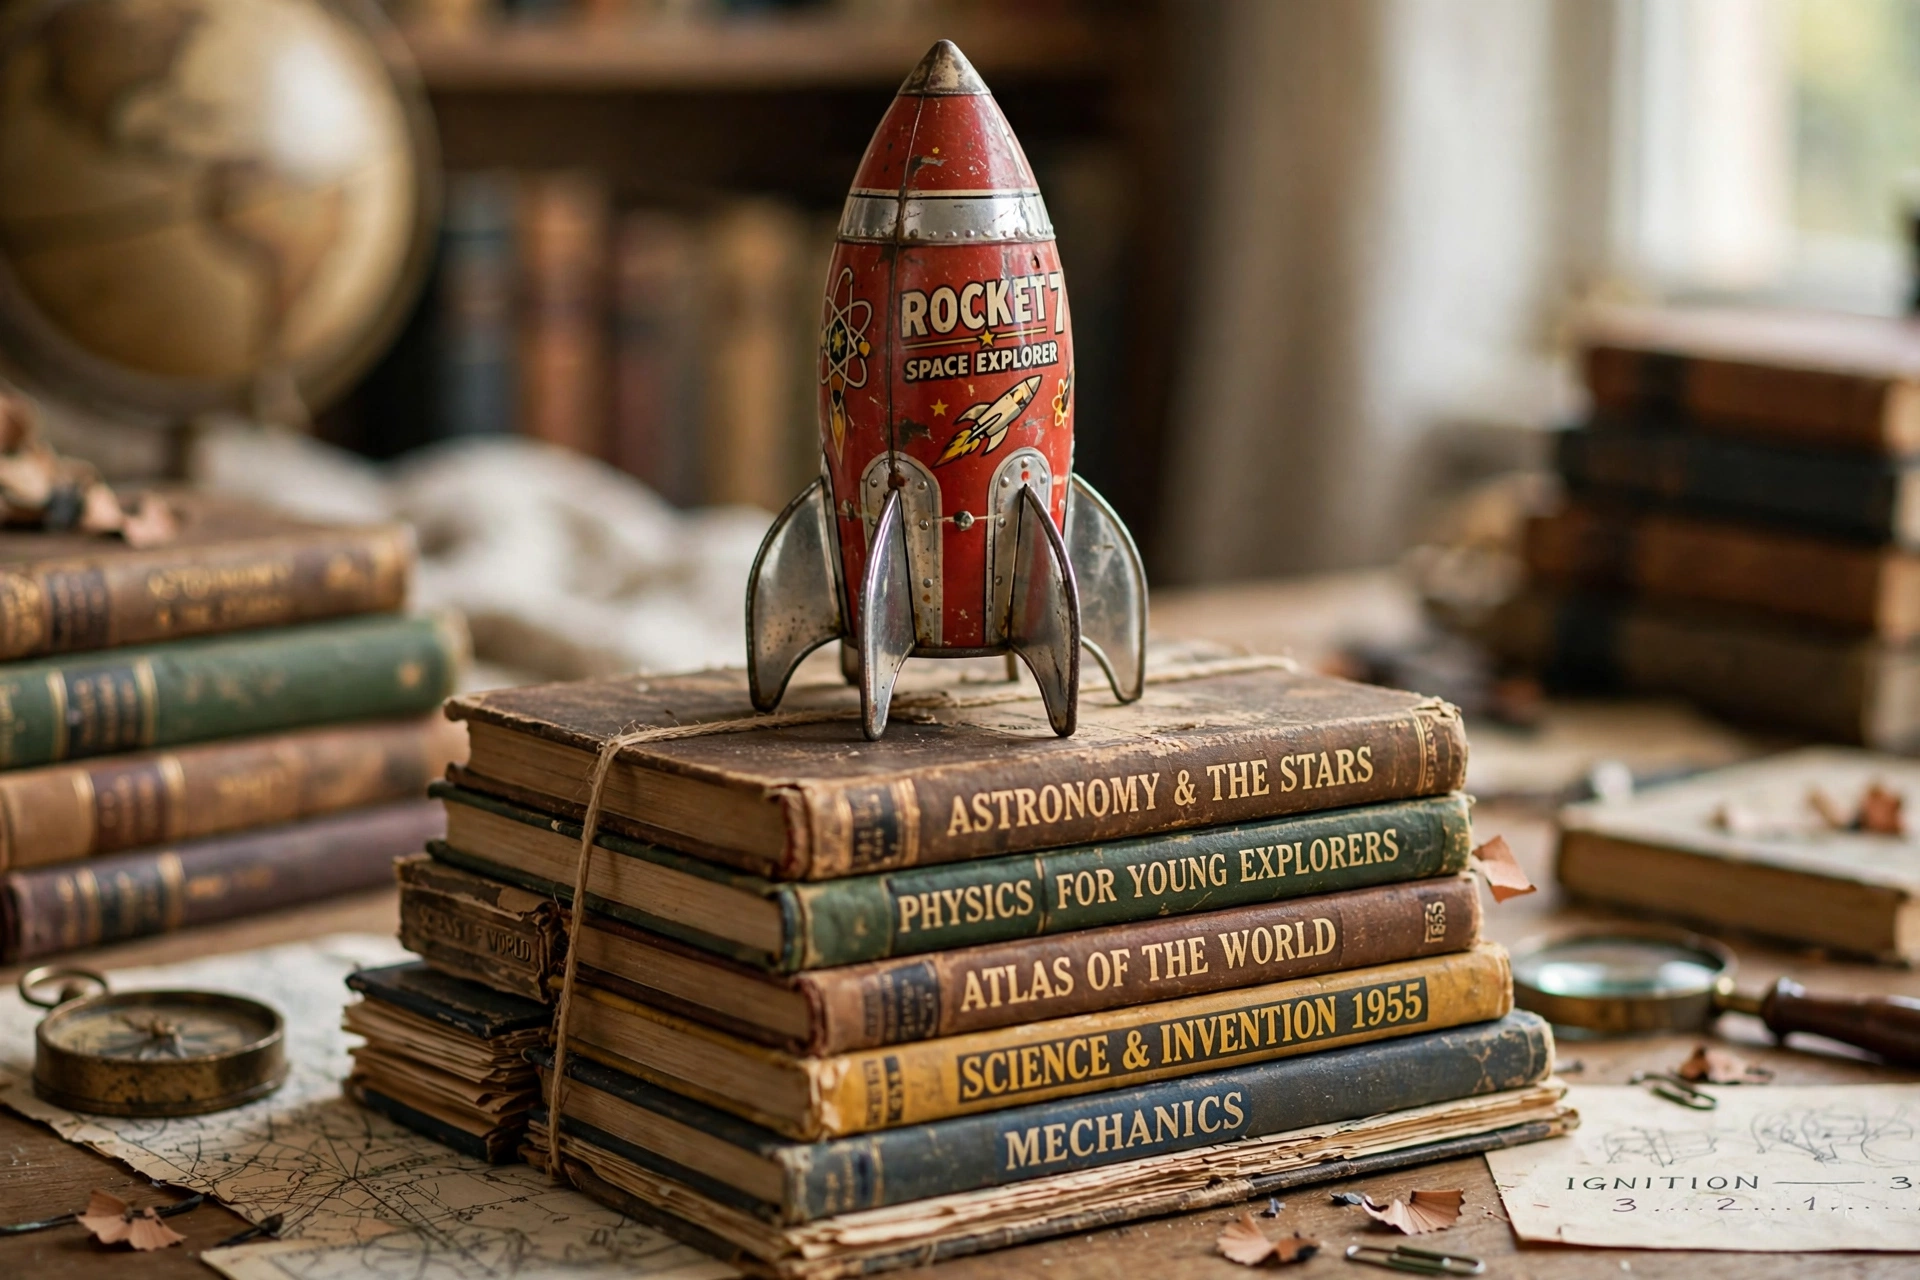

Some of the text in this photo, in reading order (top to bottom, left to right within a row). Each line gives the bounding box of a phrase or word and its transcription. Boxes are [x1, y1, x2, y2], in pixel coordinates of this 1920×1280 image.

[902, 272, 1067, 338] ROCKET 7
[905, 341, 1058, 380] SPACE EXPLORER
[947, 773, 1160, 836] ASTRONOMY
[1174, 770, 1197, 806] &
[1206, 760, 1270, 801] THE
[1280, 746, 1374, 793] STARS
[897, 828, 1400, 933] PHYSICS FOR YOUNG EXPLORERS
[960, 956, 1075, 1012] ATLAS
[1087, 949, 1131, 991] OF
[1141, 936, 1210, 981] THE
[1218, 917, 1337, 969] WORLD
[961, 1034, 1111, 1099] SCIENCE
[1122, 1029, 1151, 1070] &
[1160, 996, 1337, 1064] INVENTION
[1352, 982, 1423, 1029] 1955
[1004, 1091, 1245, 1171] MECHANICS
[1566, 1175, 1759, 1191] IGNITION
